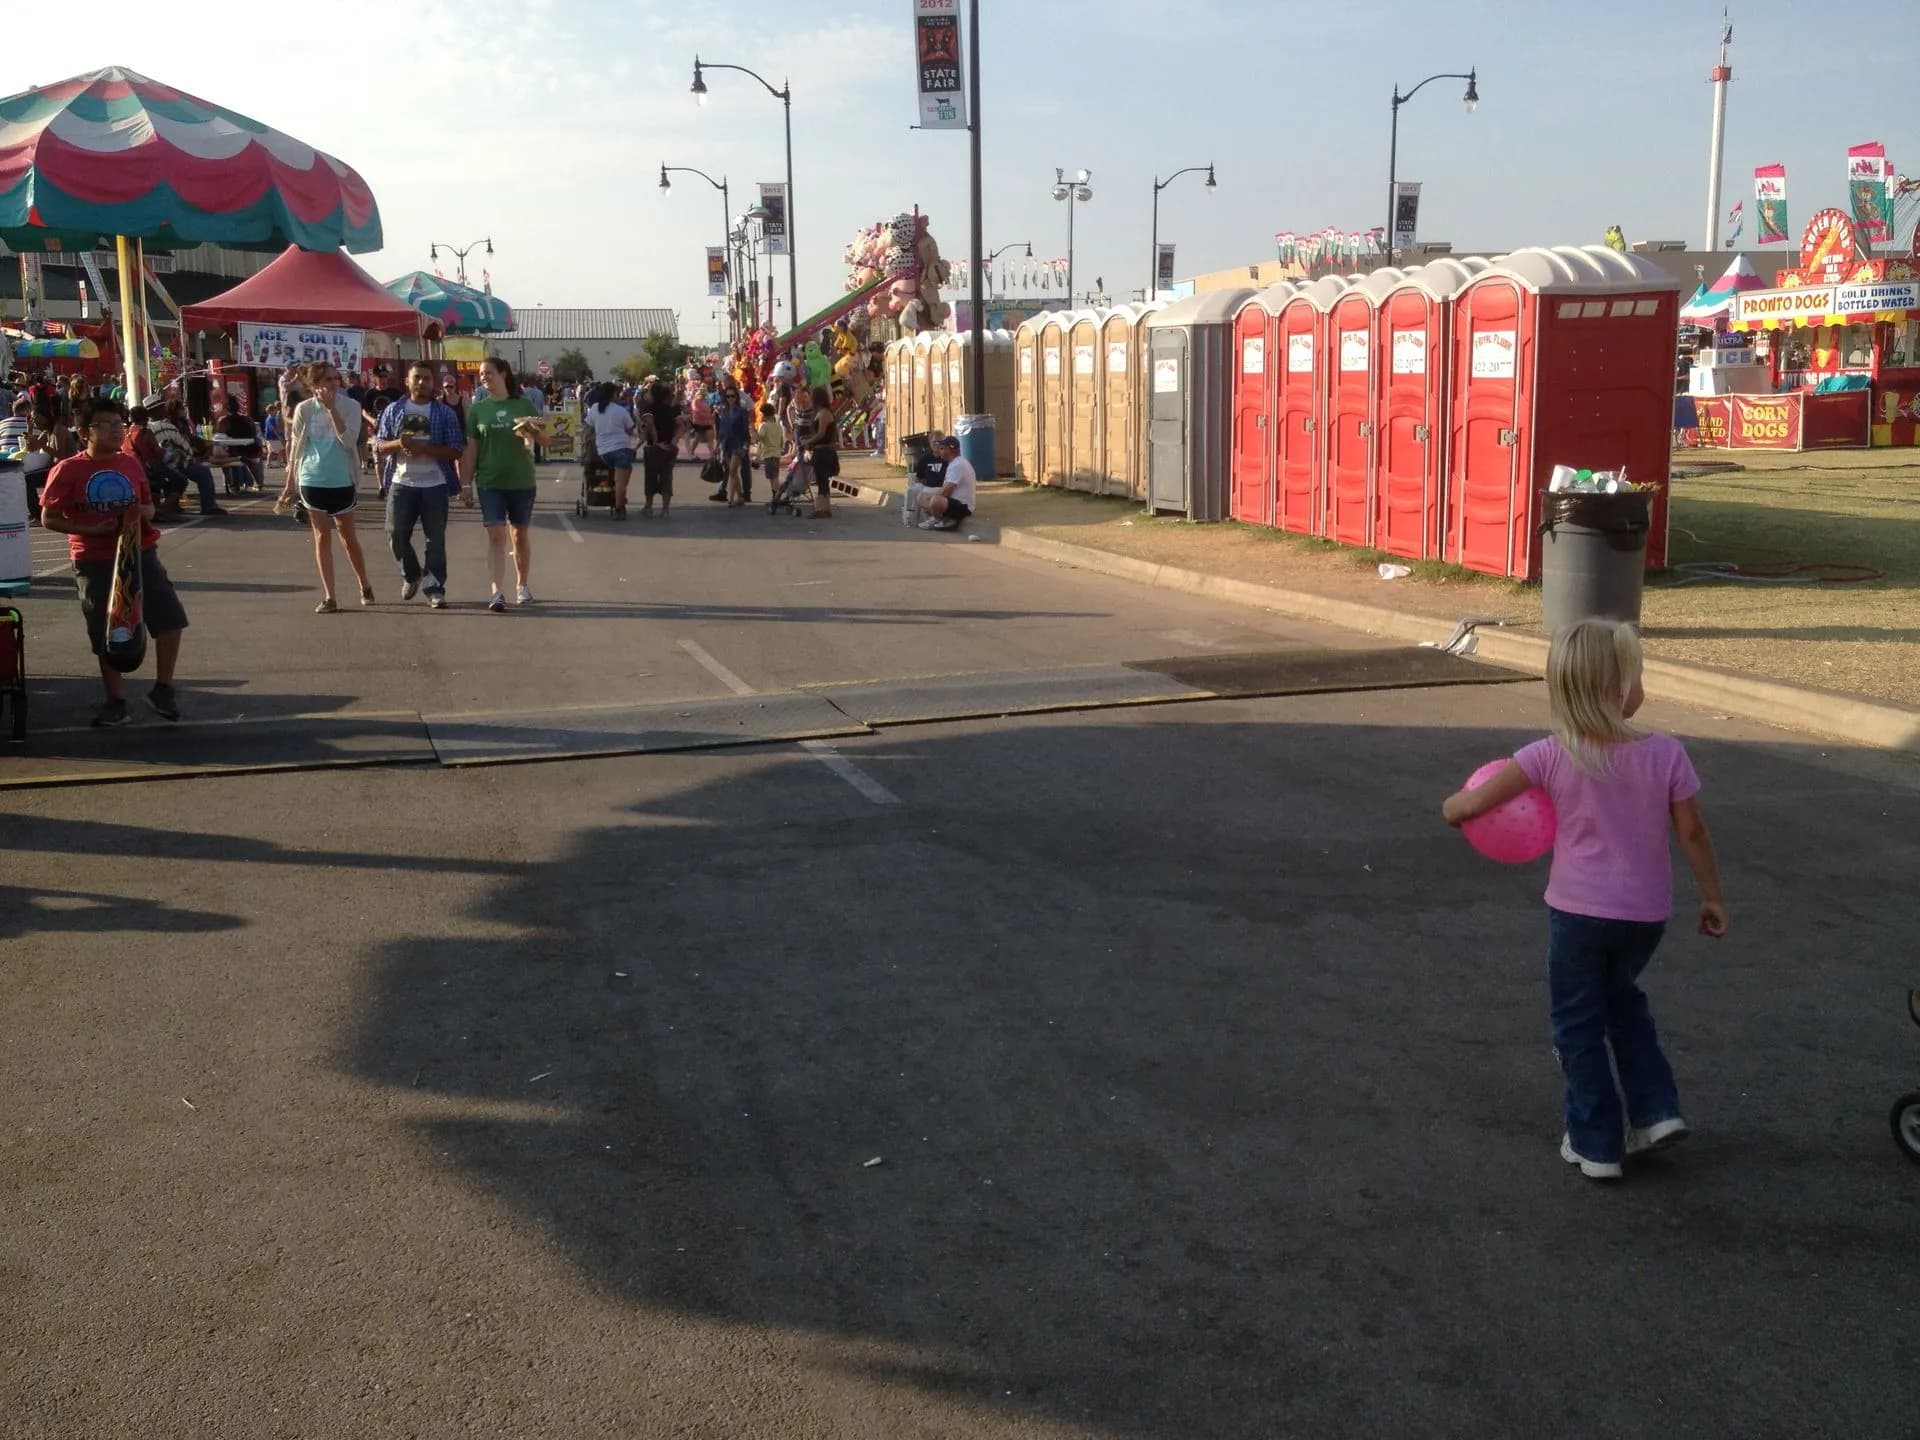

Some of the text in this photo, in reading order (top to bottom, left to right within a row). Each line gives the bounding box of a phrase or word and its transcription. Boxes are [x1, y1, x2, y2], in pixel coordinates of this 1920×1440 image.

[924, 69, 957, 79] STATE
[926, 79, 956, 89] FAIR
[1841, 286, 1912, 300] COLD DRINKS
[1743, 296, 1793, 314] PRONTO
[1795, 292, 1829, 310] DOGS
[1837, 296, 1915, 311] BOTTLED WATER
[258, 330, 288, 341] ICE
[1718, 351, 1752, 364] ICE
[1742, 406, 1789, 421] CORN
[1742, 423, 1789, 438] DOGS
